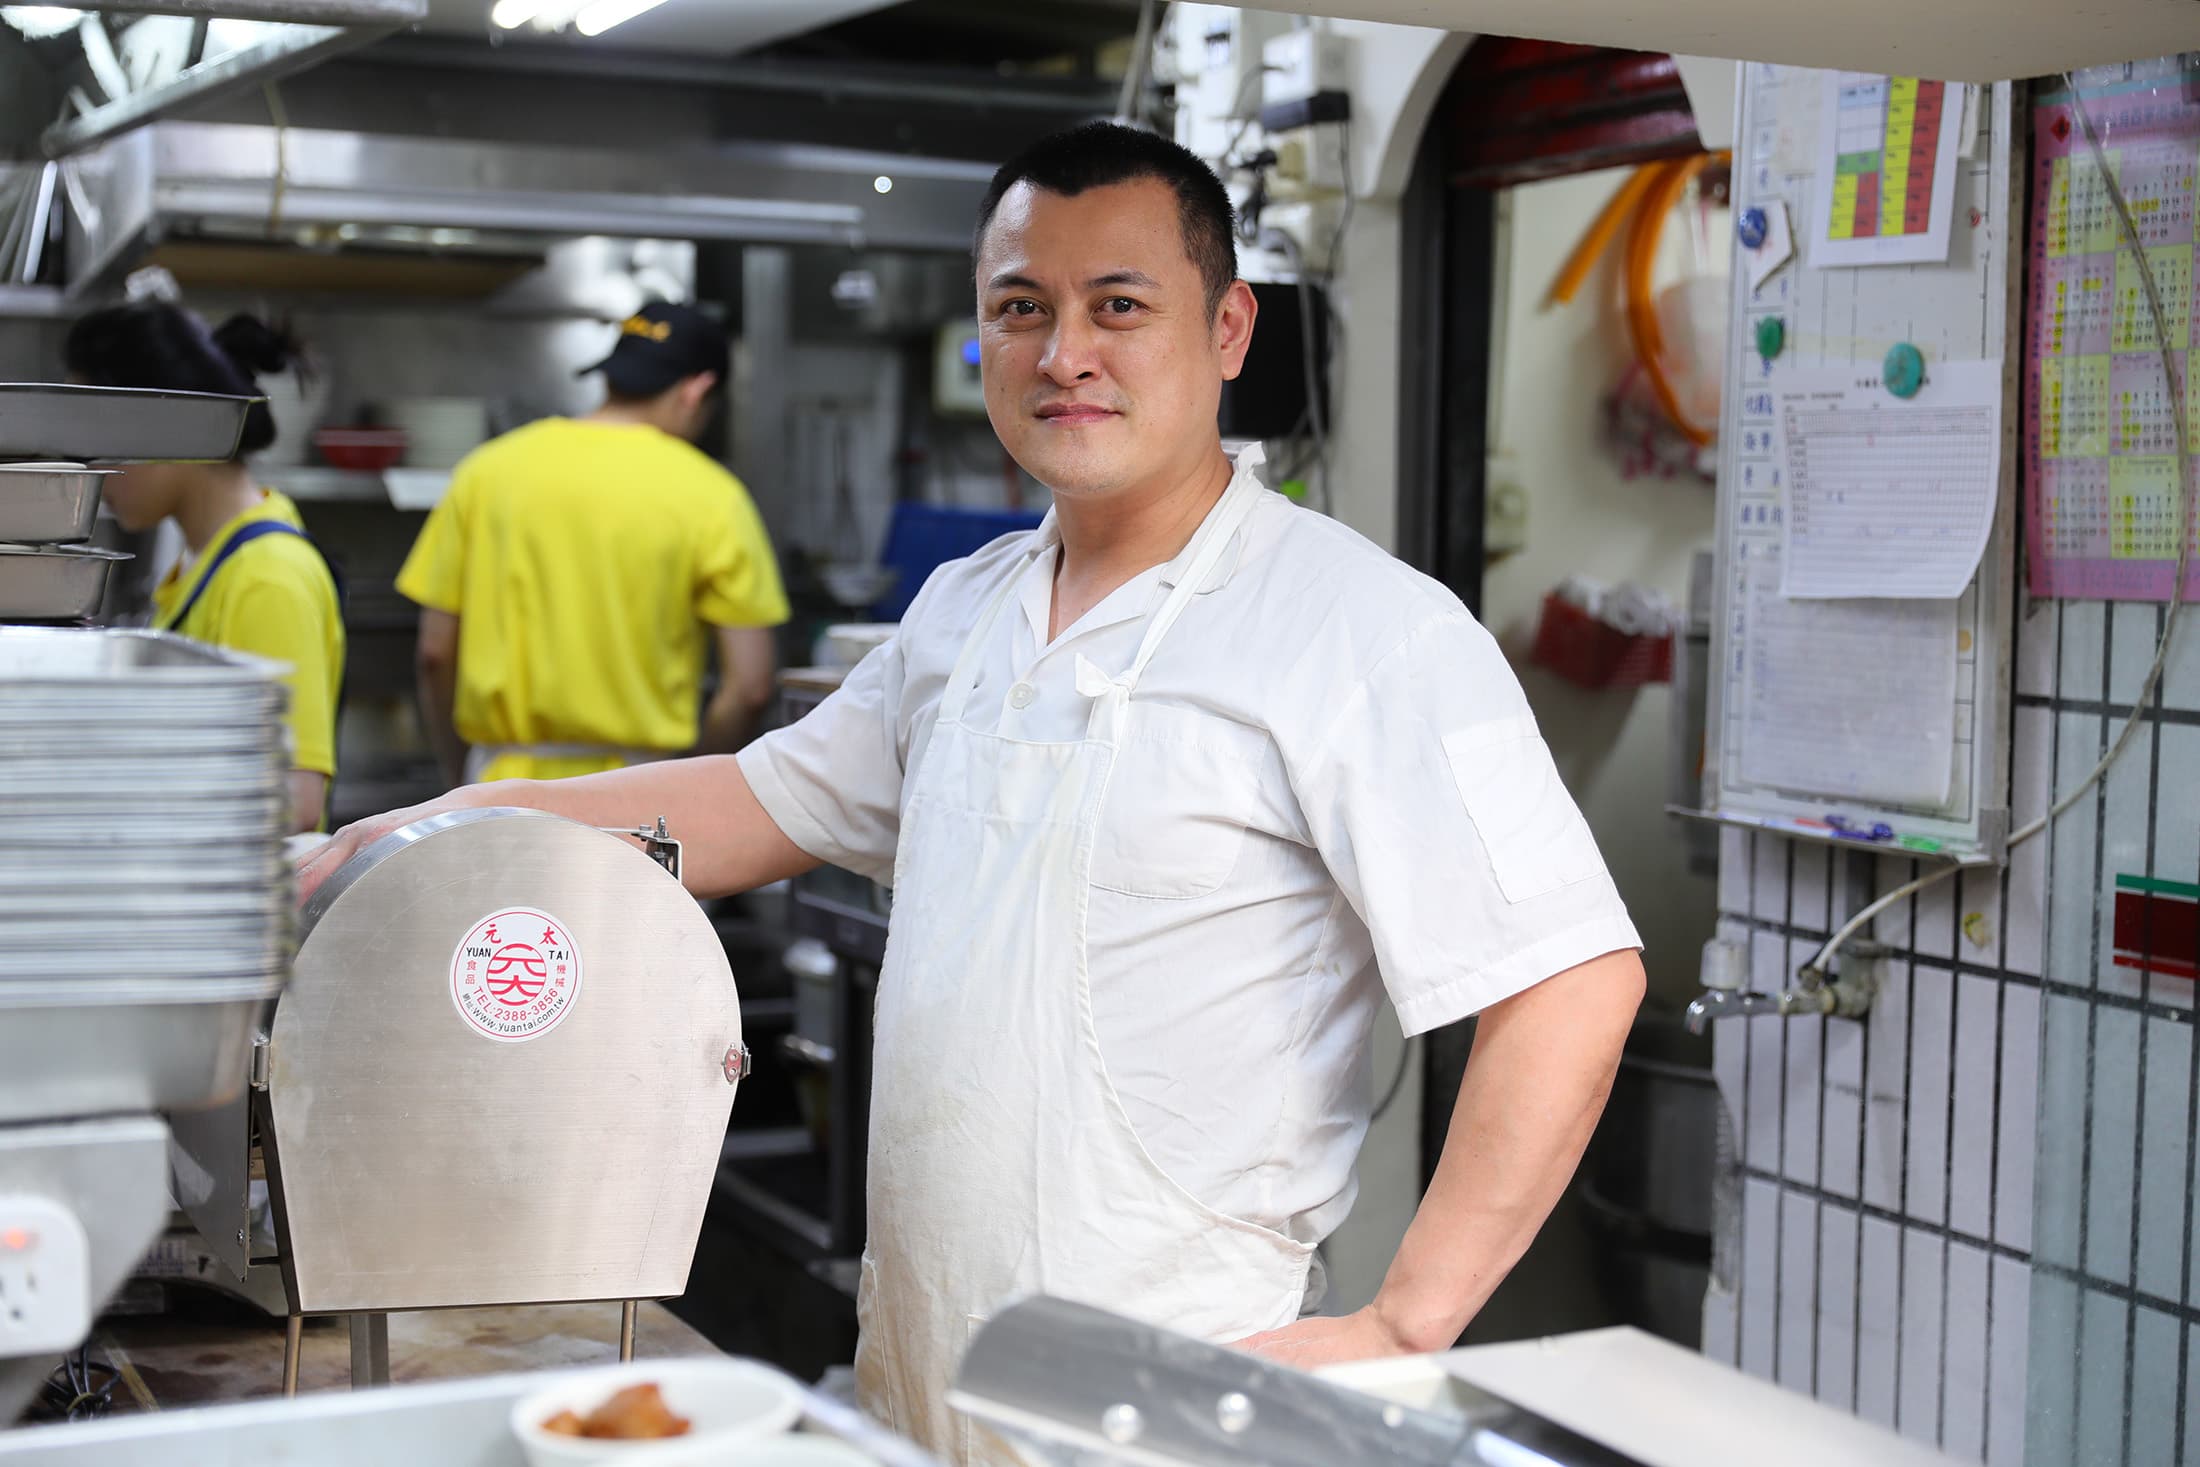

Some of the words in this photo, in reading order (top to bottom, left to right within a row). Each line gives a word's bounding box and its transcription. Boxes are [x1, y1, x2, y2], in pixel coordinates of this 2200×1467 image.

[482, 924, 501, 944] 元
[539, 926, 558, 946] 太
[466, 947, 492, 958] YUAN
[549, 950, 569, 961] TAI
